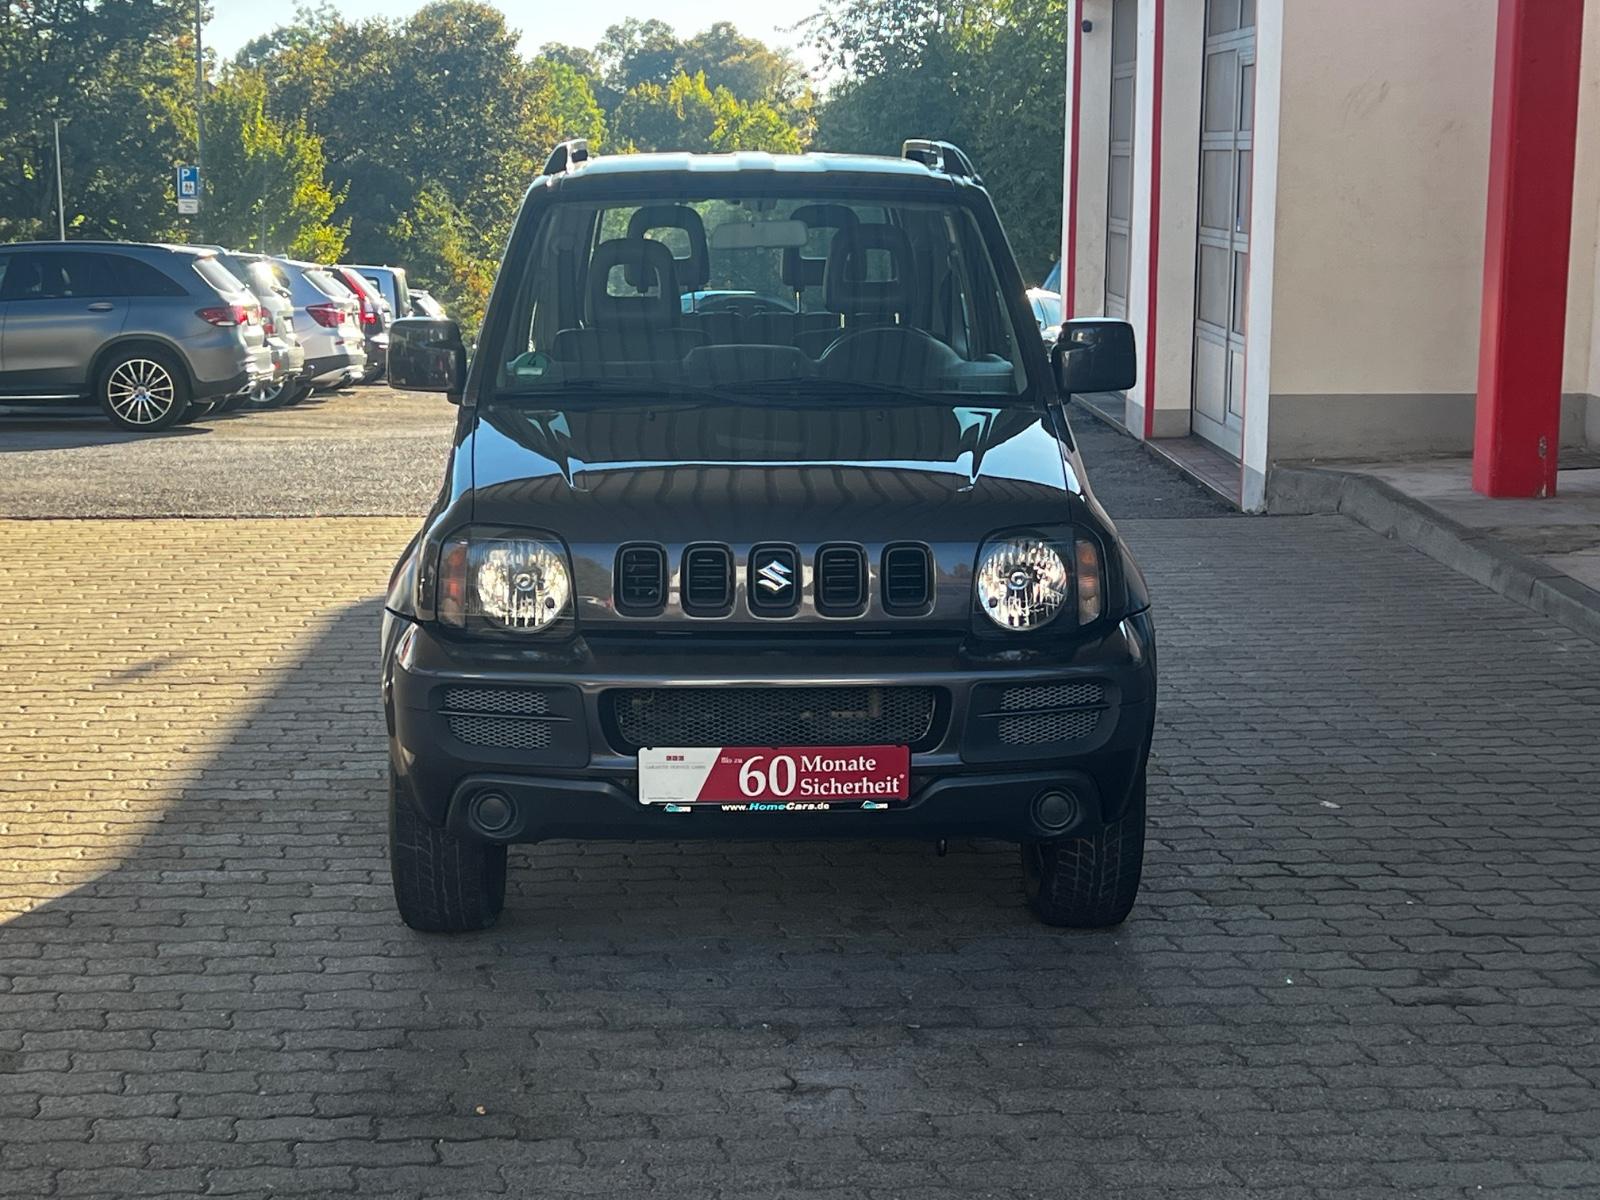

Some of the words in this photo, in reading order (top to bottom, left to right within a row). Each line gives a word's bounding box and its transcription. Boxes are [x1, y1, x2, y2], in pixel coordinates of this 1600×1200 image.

[181, 168, 191, 181] P
[800, 754, 877, 773] Monate
[738, 755, 796, 797] 60
[721, 802, 830, 811] www.HomeCars.de
